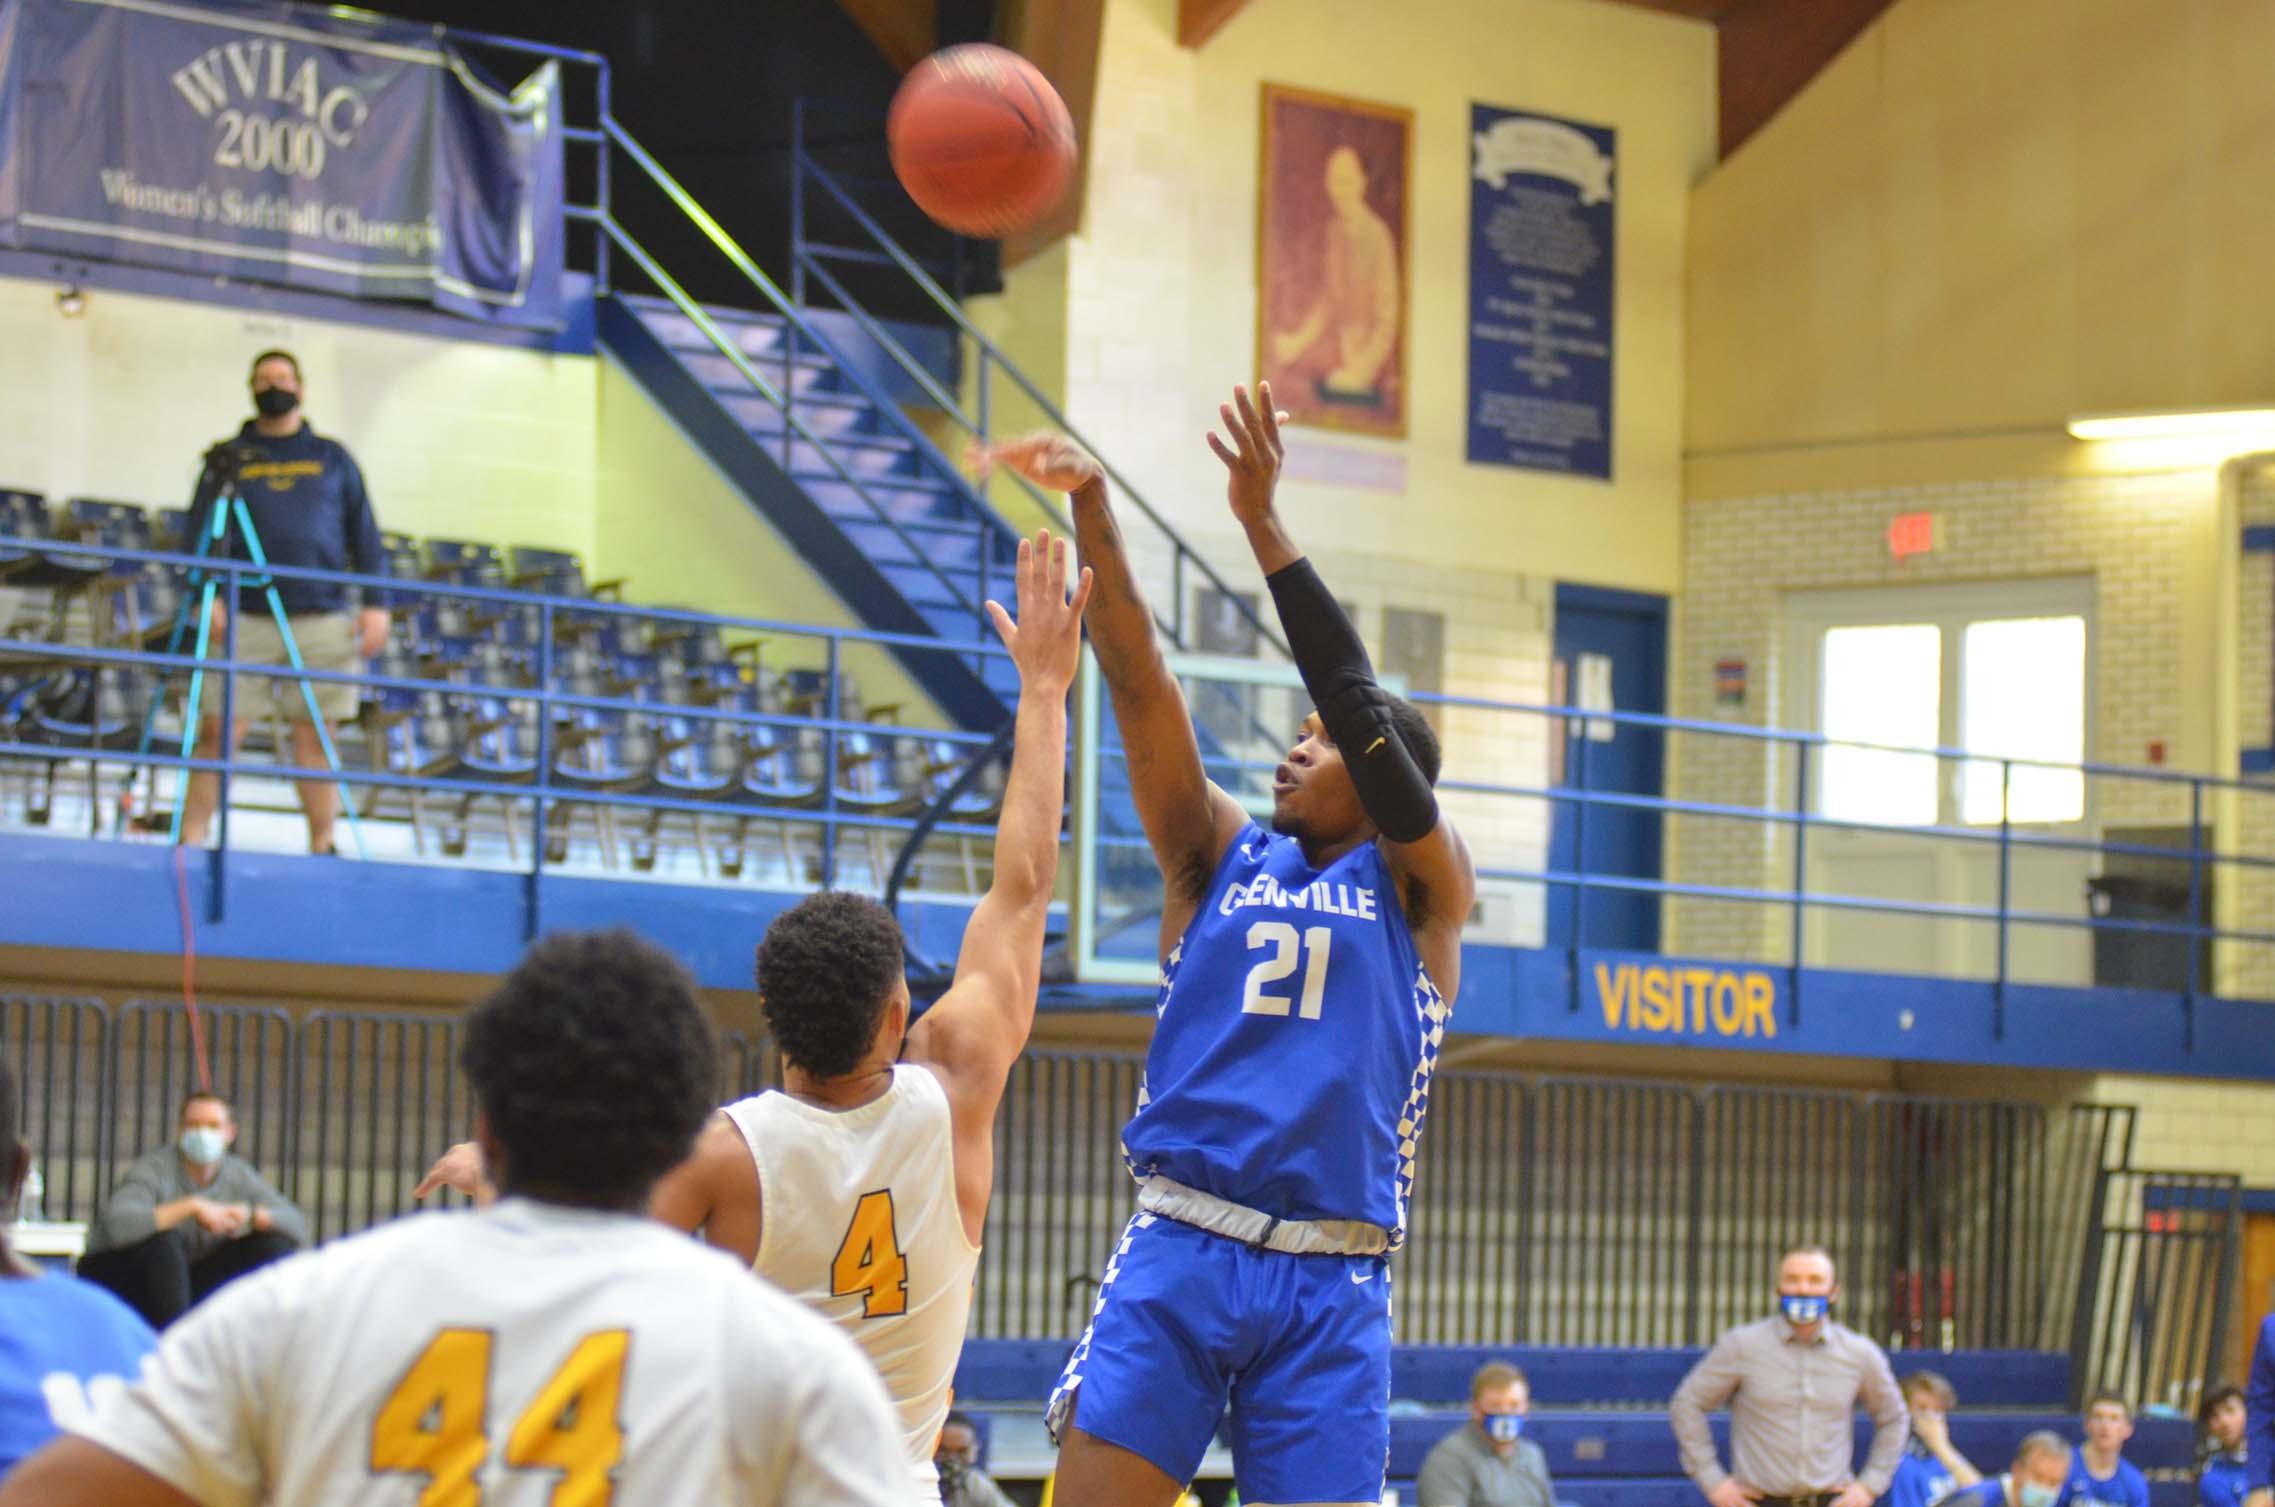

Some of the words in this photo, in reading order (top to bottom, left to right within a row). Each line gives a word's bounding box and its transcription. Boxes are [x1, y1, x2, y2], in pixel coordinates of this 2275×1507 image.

[172, 38, 368, 148] WVIAC
[213, 108, 326, 181] 2000
[101, 168, 219, 222] Women's
[220, 187, 324, 239] Softball
[1218, 873, 1377, 921] GENVILLE
[1241, 921, 1332, 1020] 21
[1594, 961, 1777, 1039] VISITOR
[830, 1188, 908, 1319] 4
[369, 1326, 633, 1507] 44
